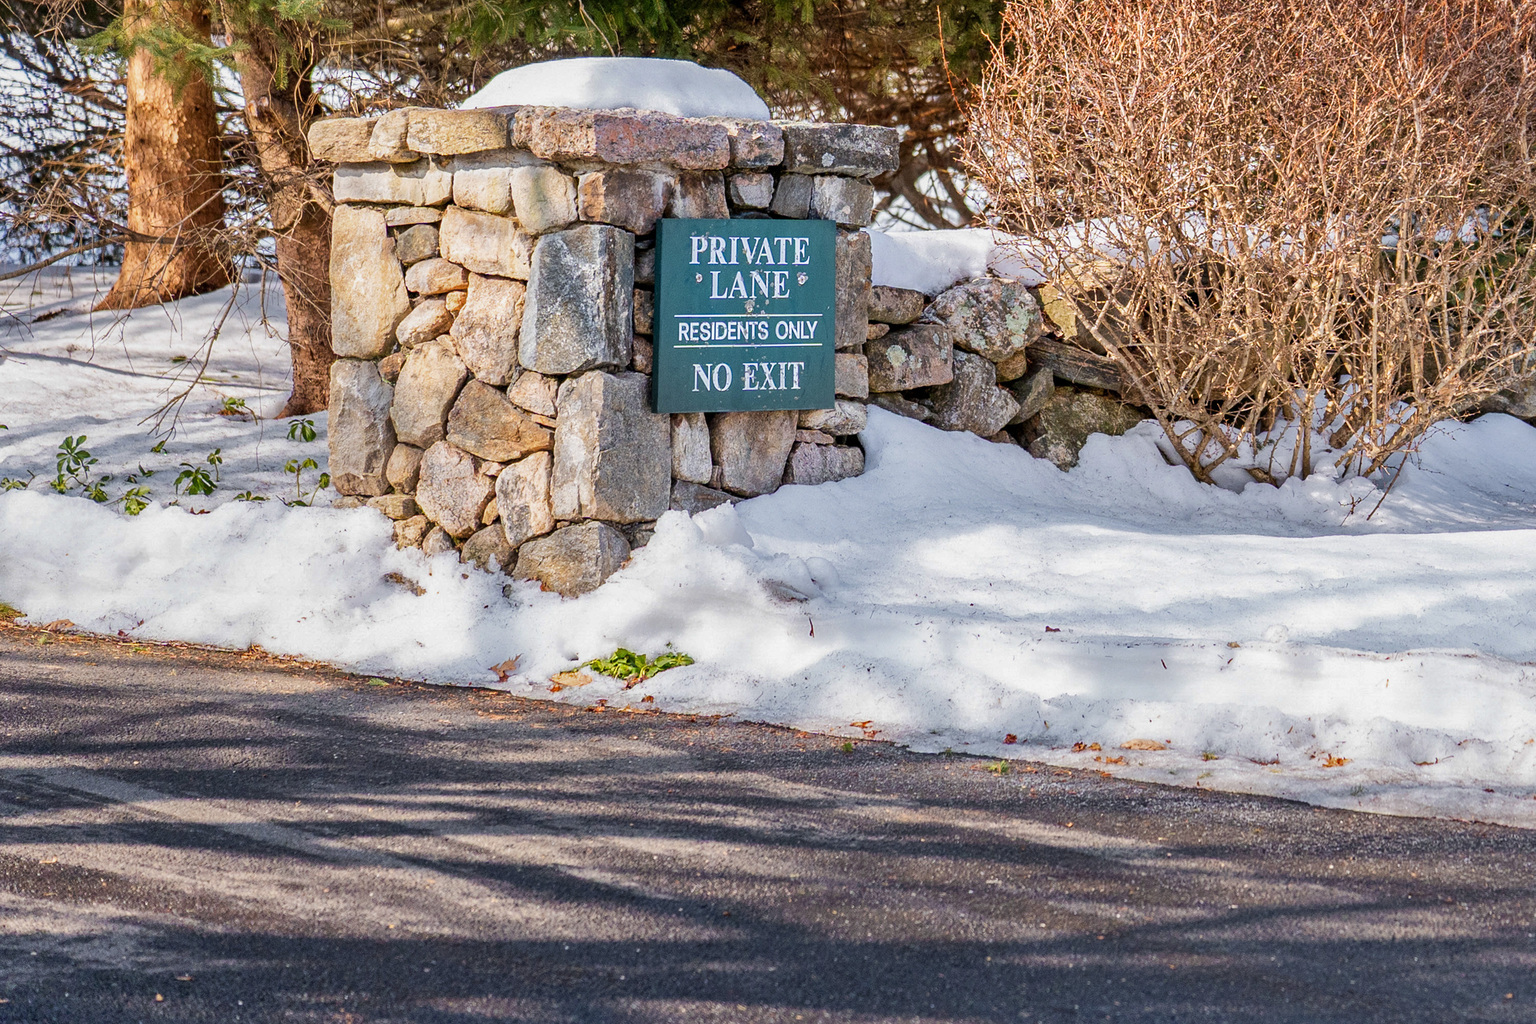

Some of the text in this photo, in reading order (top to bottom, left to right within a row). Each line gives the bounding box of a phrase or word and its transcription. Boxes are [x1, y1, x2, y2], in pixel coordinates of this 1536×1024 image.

[688, 235, 811, 266] PRIVATE
[709, 270, 790, 299] LANE
[678, 320, 818, 342] RESIDENTS ONLY
[691, 361, 805, 392] NO EXIT
